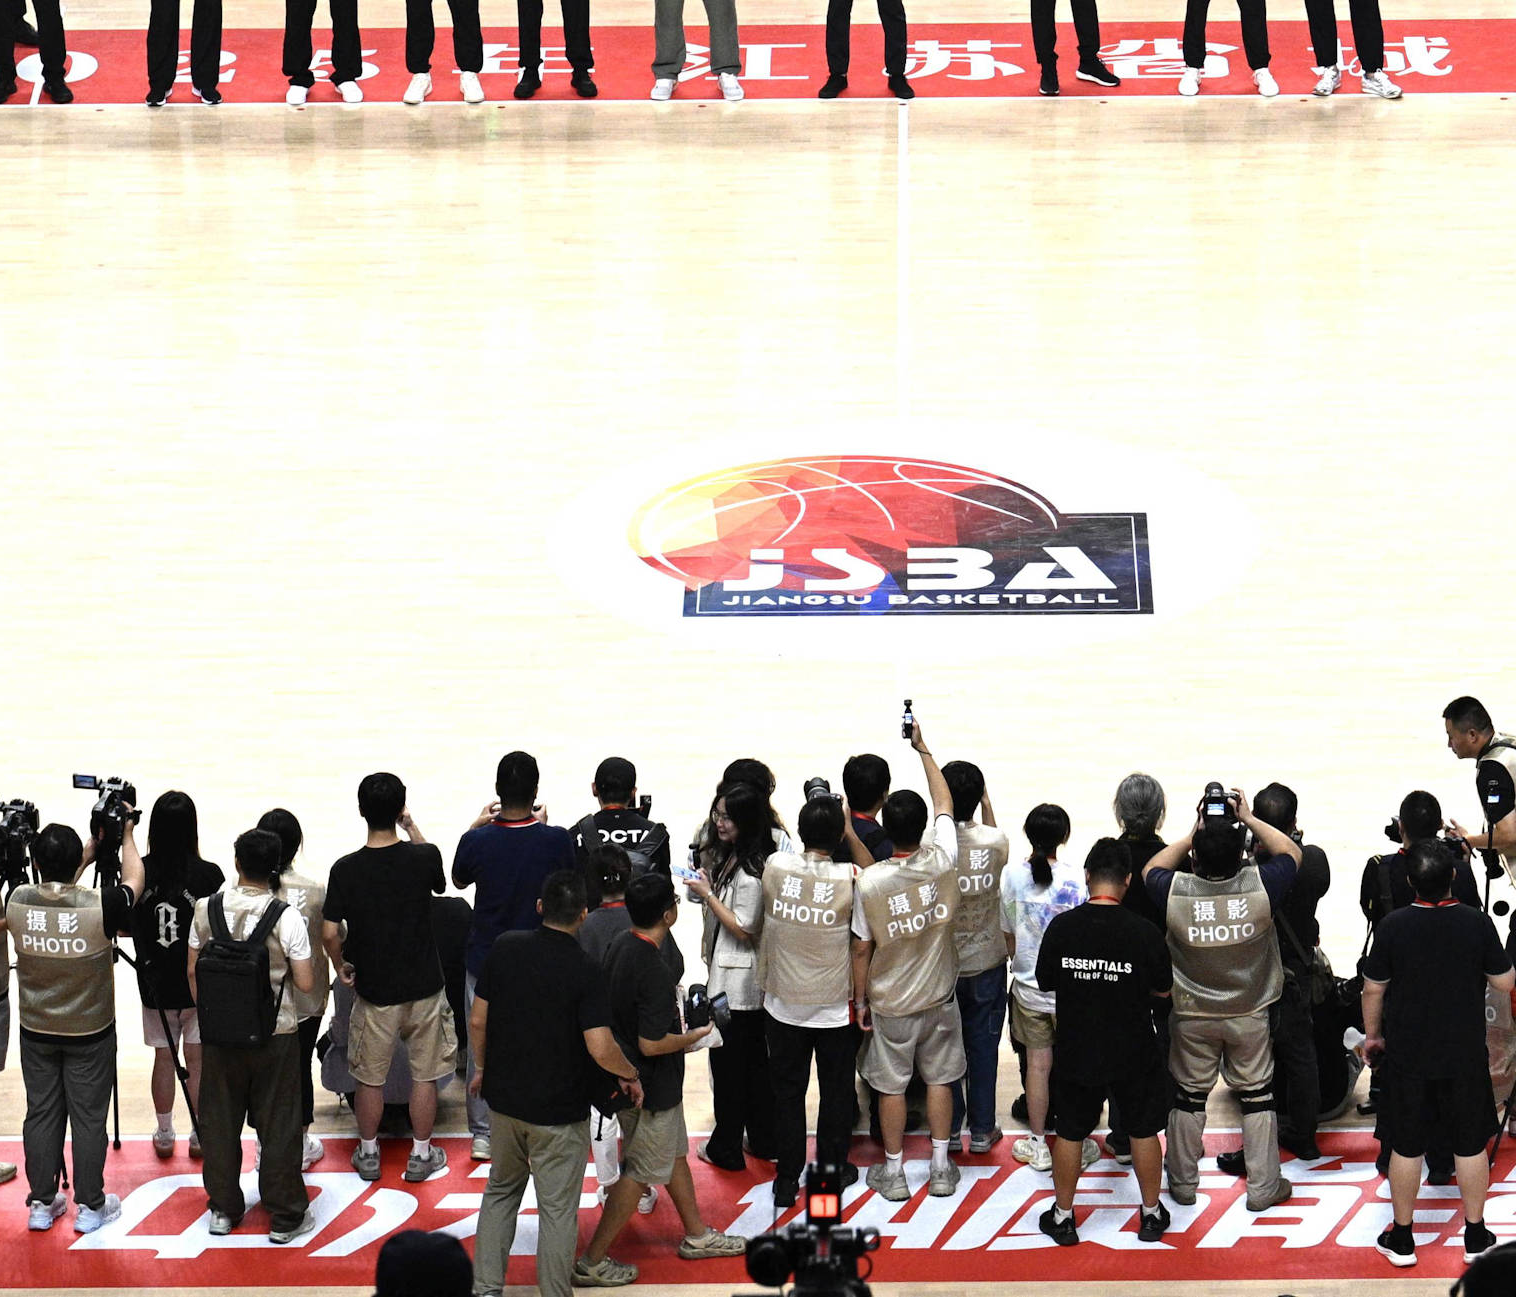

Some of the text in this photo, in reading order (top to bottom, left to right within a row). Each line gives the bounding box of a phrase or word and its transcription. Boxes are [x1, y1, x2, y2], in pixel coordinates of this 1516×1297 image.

[722, 545, 1118, 592] JSBA
[722, 593, 1119, 607] JIANGSU BASKETBALL
[781, 874, 835, 904] 摄影
[887, 881, 939, 917] 摄影
[26, 908, 81, 934] 摄影
[772, 898, 837, 926] PHOTO
[886, 902, 949, 939] PHOTO
[1193, 898, 1250, 923] 摄影
[21, 933, 86, 955] PHOTO
[1187, 921, 1256, 944] PHOTO
[1061, 956, 1133, 974] ESSENTIALS
[1074, 970, 1119, 983] FEAR OF GOD
